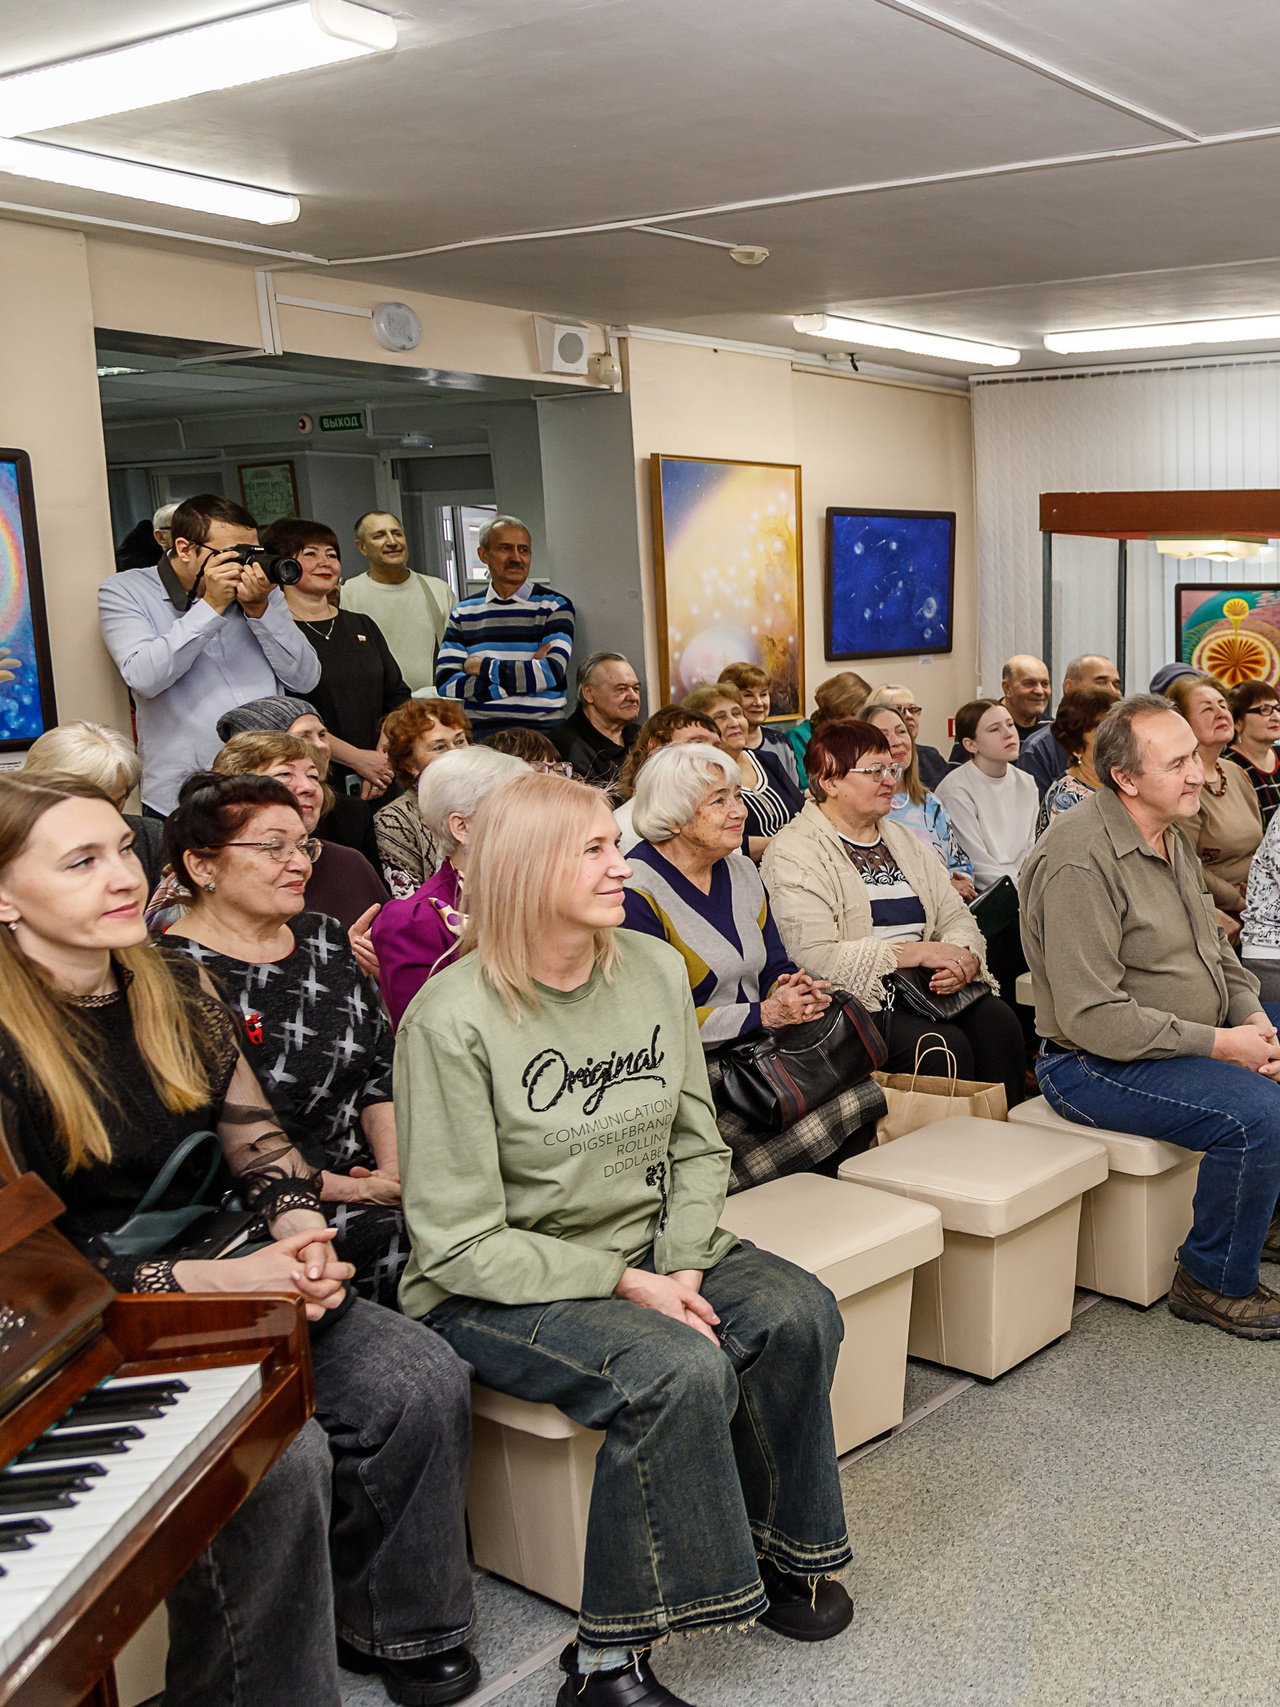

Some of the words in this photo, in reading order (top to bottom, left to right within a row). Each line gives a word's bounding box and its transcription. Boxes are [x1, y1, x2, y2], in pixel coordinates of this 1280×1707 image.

[323, 416, 359, 429] ВЫХОД
[522, 1024, 666, 1115] Original
[543, 1096, 673, 1147] COMMUNICATION
[569, 1113, 673, 1156] DIGSELFBRAND
[604, 1144, 667, 1178] DDDLABEL
[616, 1127, 669, 1157] ROLLING
